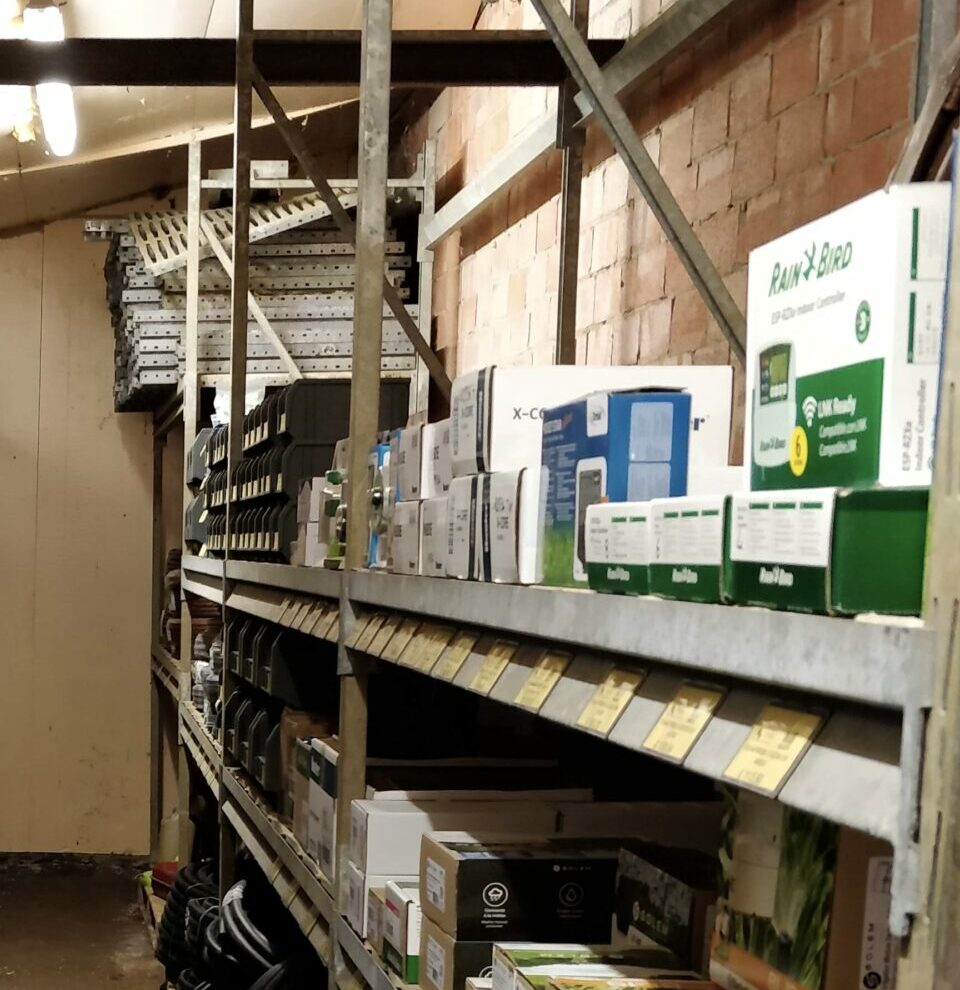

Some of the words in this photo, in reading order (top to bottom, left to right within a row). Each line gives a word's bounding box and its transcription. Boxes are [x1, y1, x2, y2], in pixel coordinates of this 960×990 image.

[768, 260, 803, 297] RAIN
[816, 241, 852, 279] BIRD
[795, 434, 802, 457] 6
